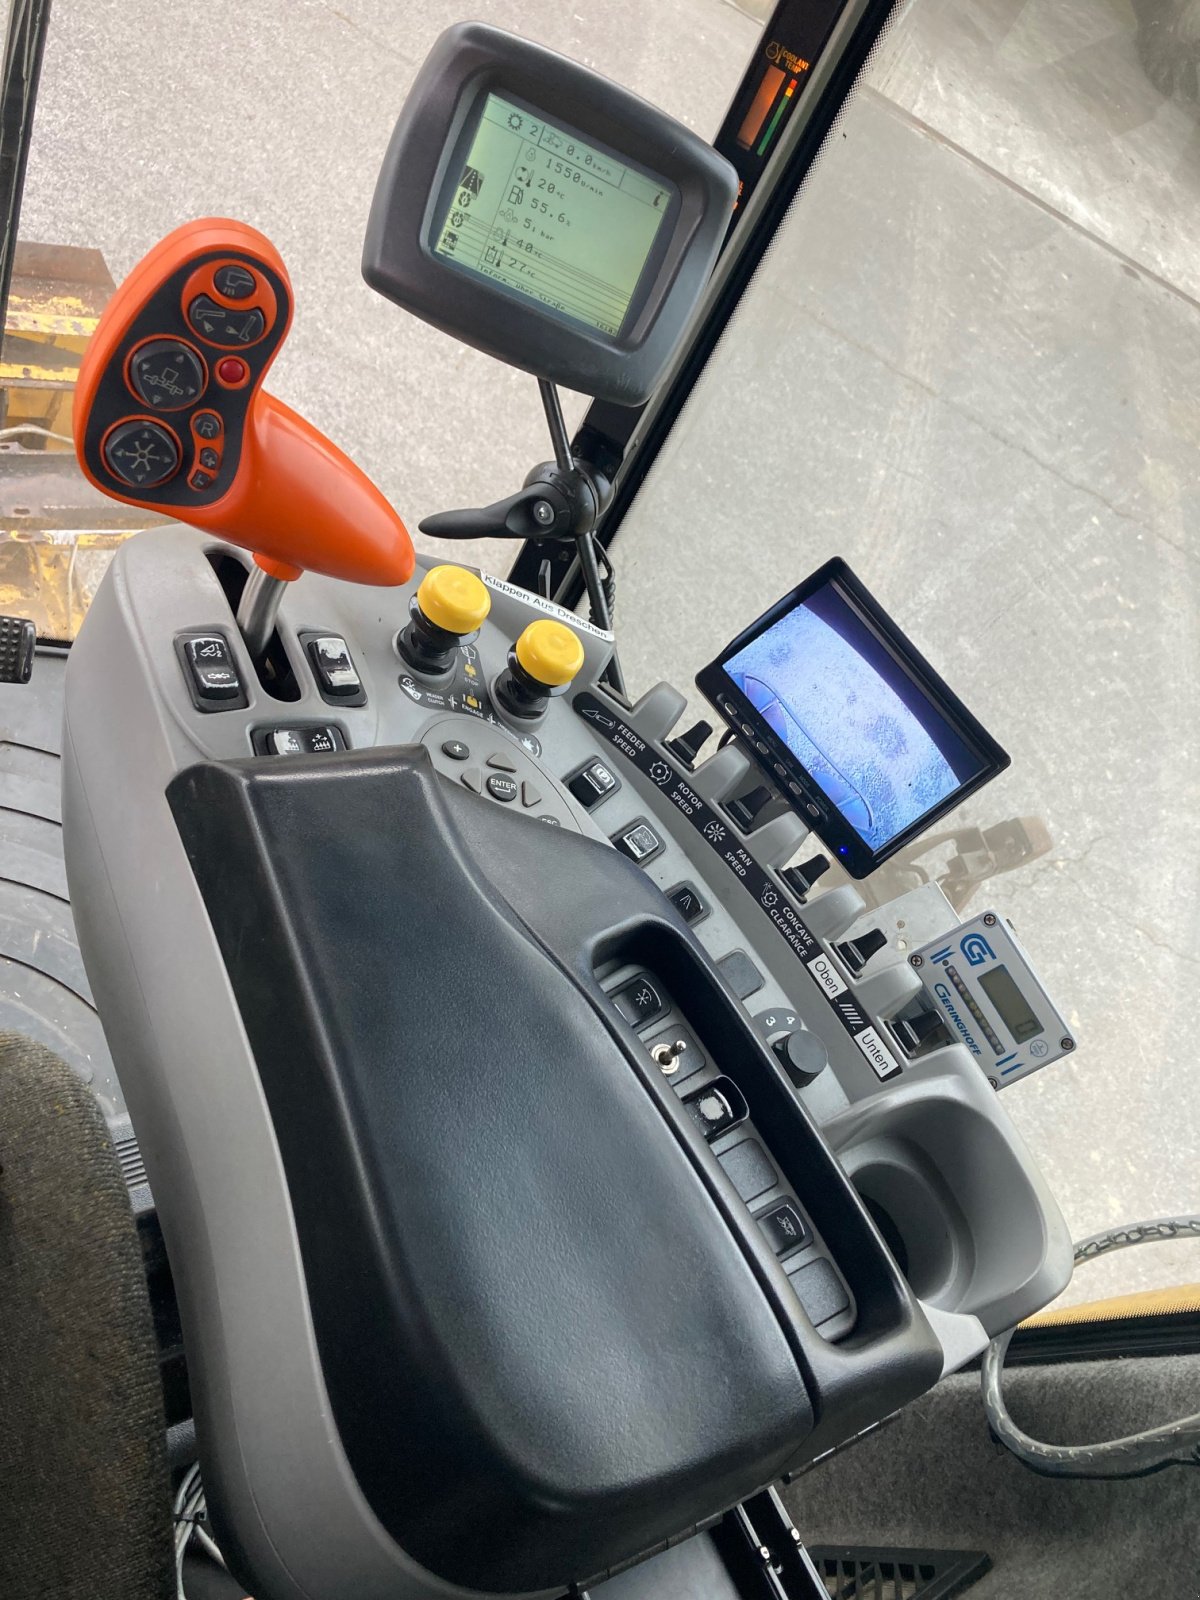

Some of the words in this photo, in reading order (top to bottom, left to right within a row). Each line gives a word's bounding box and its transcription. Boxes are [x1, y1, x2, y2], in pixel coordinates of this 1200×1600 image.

[530, 125, 538, 137] 2
[545, 158, 581, 183] 1550
[201, 421, 213, 437] R
[484, 574, 530, 601] Klappen
[533, 598, 554, 613] Aus
[557, 608, 608, 639] Dreschen
[612, 735, 636, 757] SPEED
[617, 724, 646, 752] FEEDER
[490, 778, 517, 790] ENTER
[678, 782, 702, 809] ROTOR
[671, 791, 693, 815] SPEED
[724, 851, 747, 876] SPEED
[736, 849, 752, 866] FAN
[770, 909, 808, 957] CLEARANCE
[782, 906, 814, 946] CONCAVE
[814, 960, 839, 994] Oben
[765, 1016, 776, 1027] 3
[786, 1016, 796, 1025] 4
[934, 983, 982, 1056] GERINGHOFF
[861, 1033, 889, 1071] Unten
